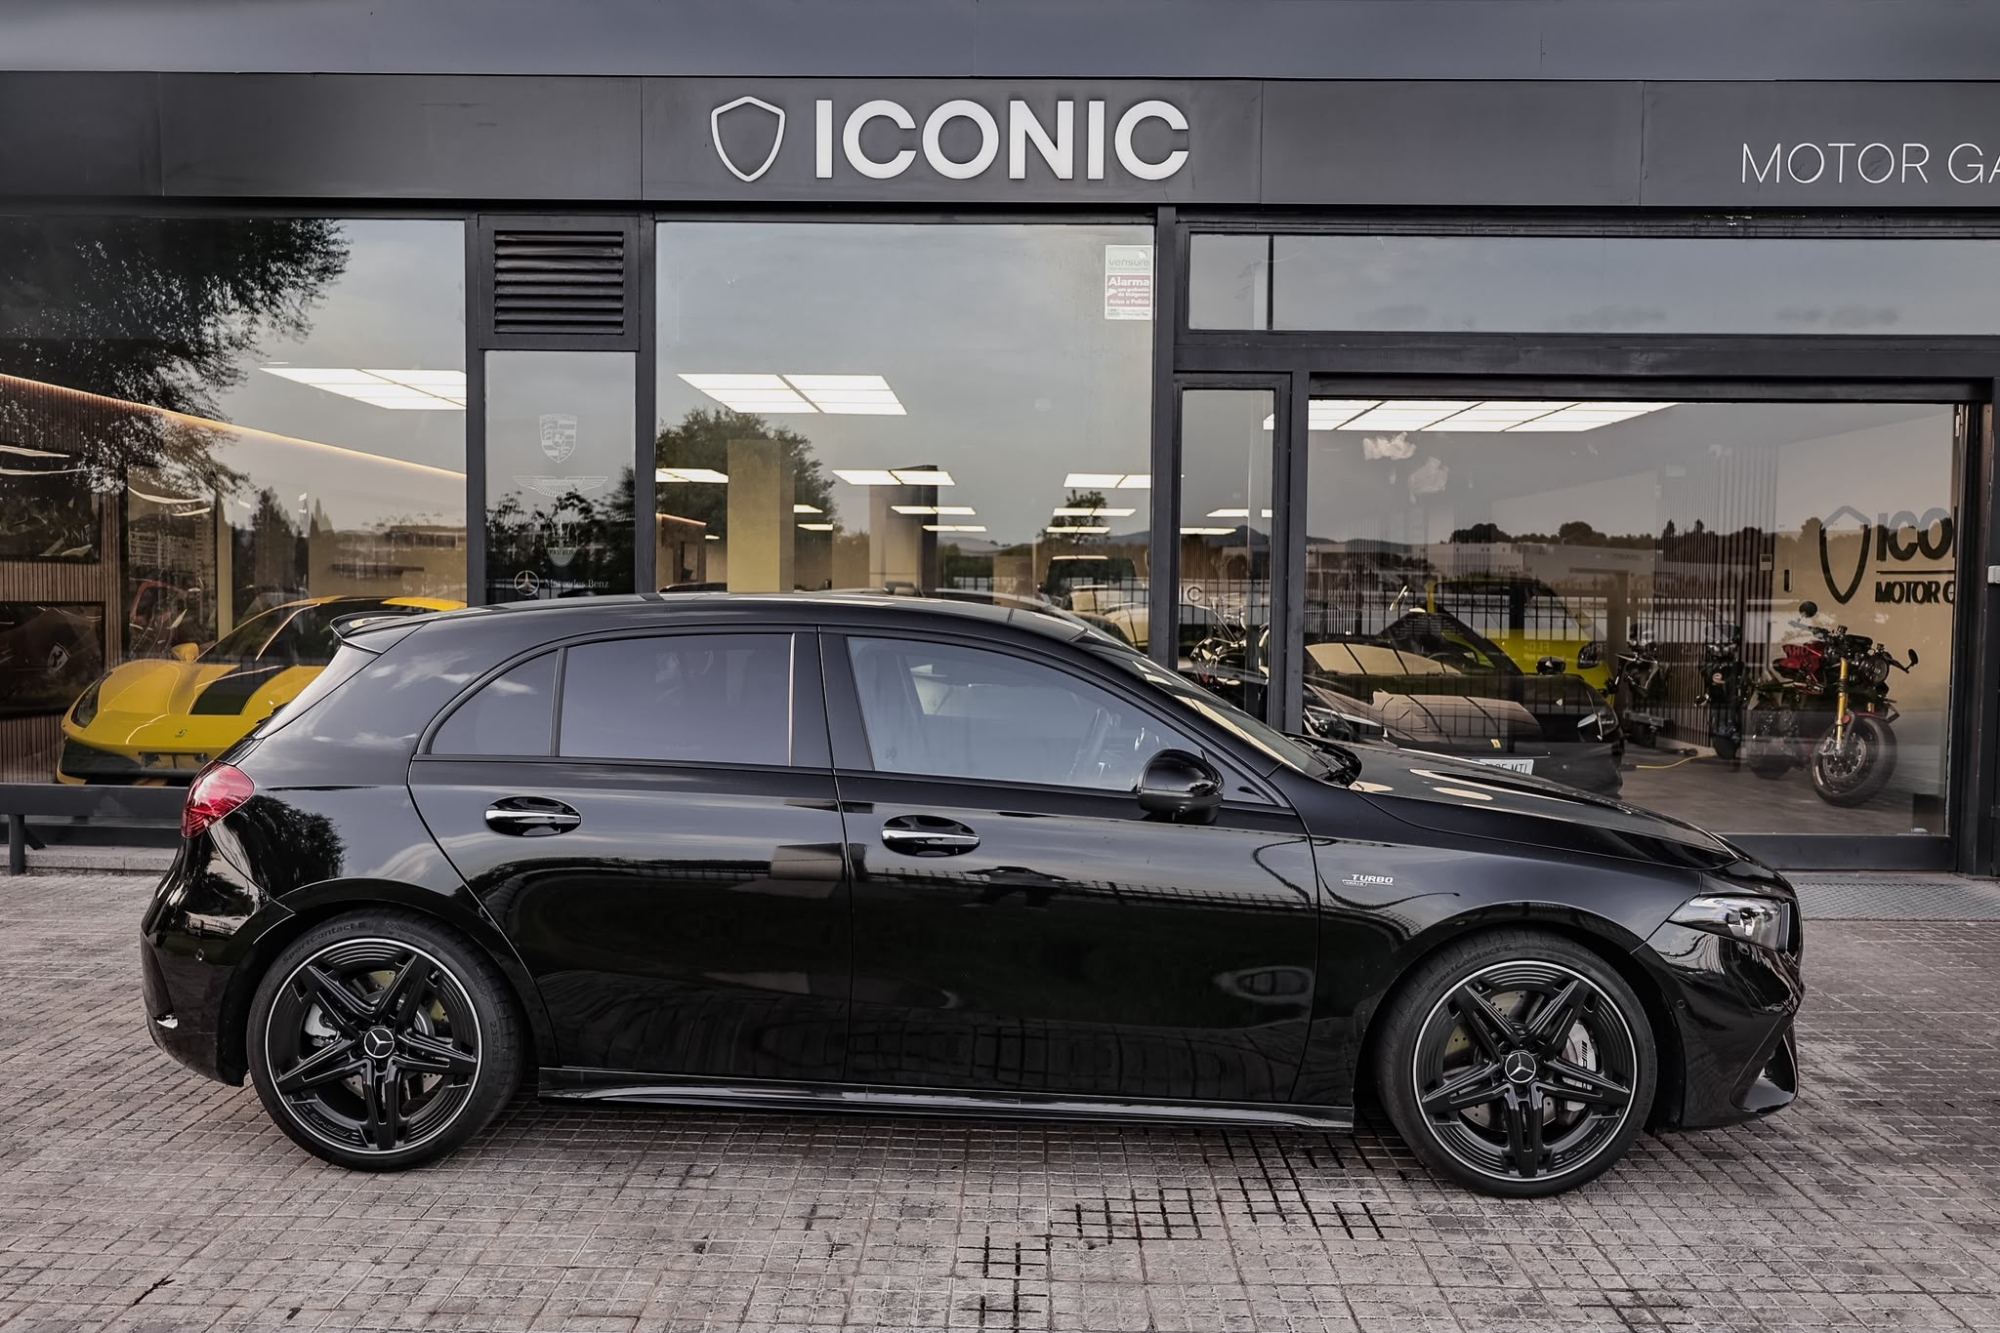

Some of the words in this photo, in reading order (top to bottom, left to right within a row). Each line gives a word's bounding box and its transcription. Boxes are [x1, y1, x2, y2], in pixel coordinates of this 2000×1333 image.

[816, 99, 1190, 180] ICONIC
[1741, 142, 1930, 185] MOTOR
[1108, 258, 1150, 267] verisure
[1108, 276, 1150, 287] Alarma
[1875, 581, 1941, 604] MOTOR
[1351, 873, 1394, 883] TURBO
